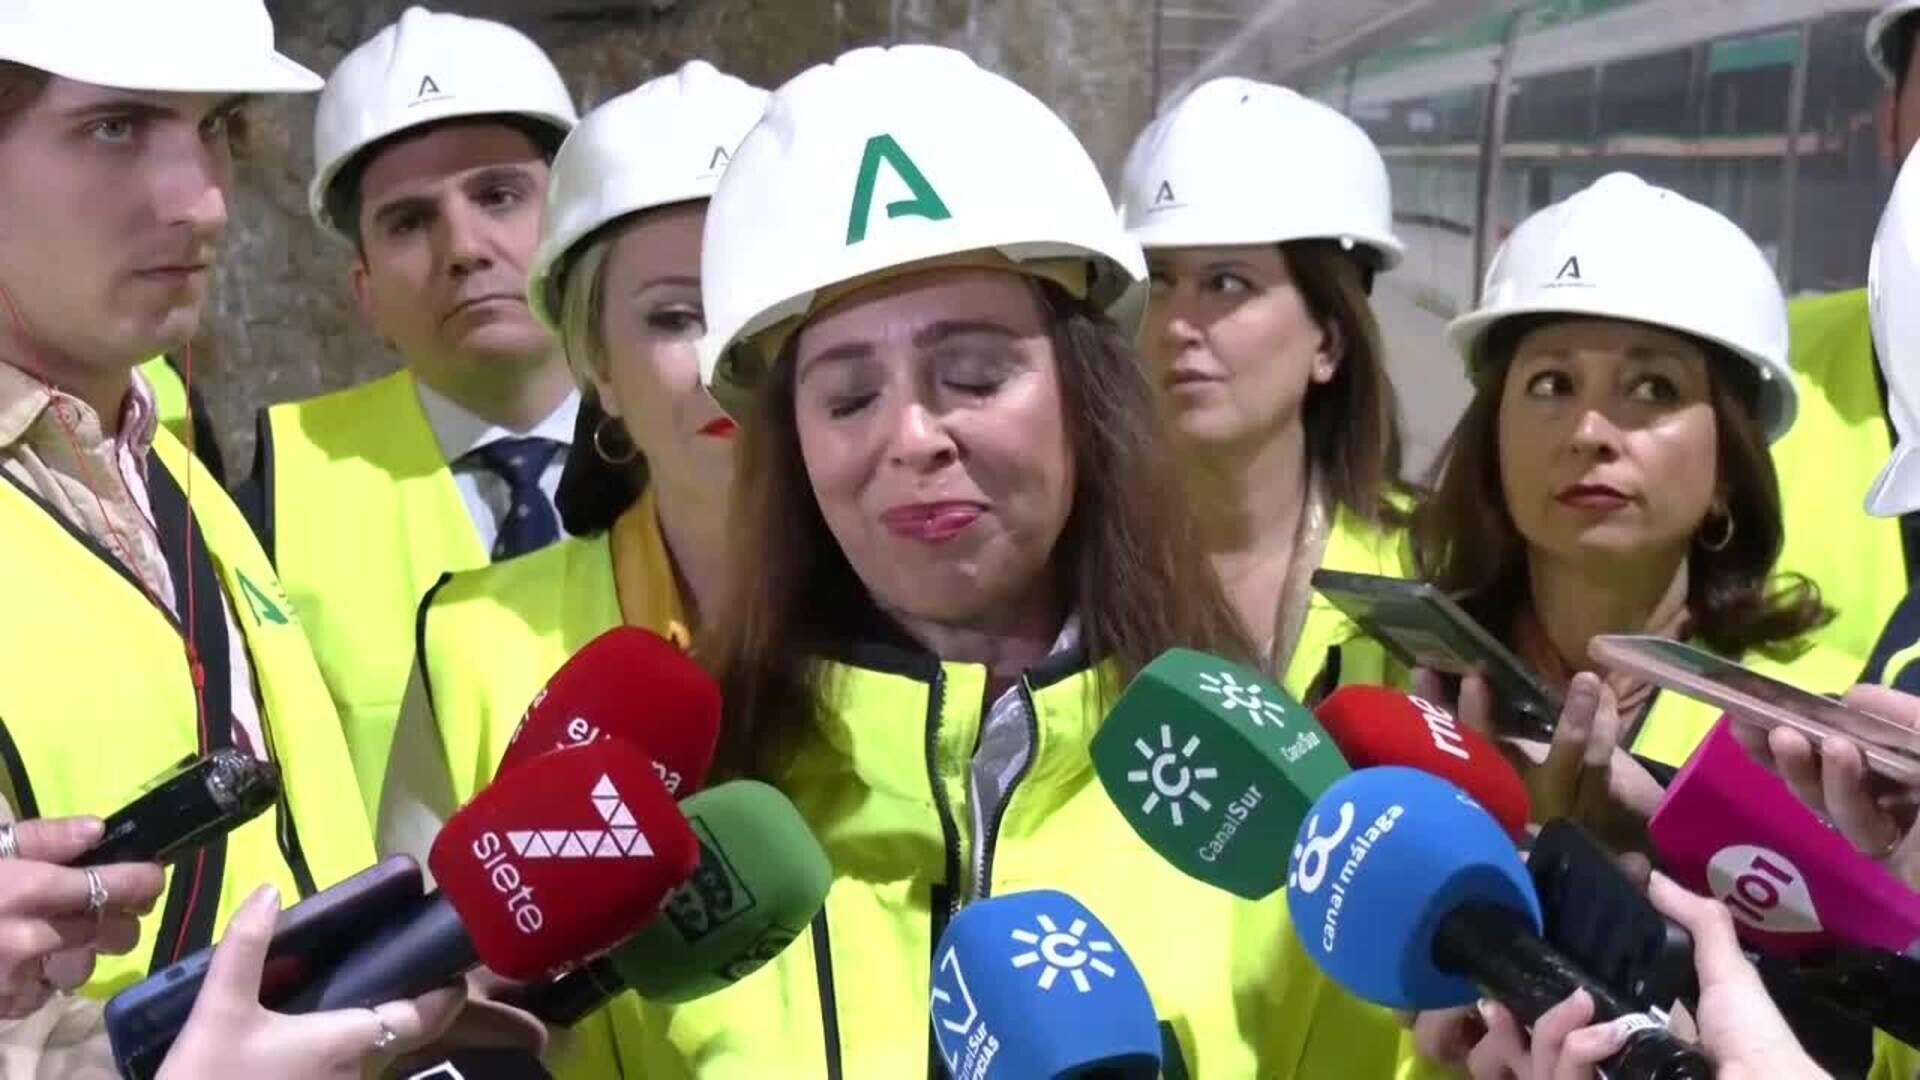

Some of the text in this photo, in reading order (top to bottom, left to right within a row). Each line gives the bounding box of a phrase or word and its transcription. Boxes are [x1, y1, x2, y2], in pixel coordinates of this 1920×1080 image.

[846, 133, 952, 246] A
[1406, 695, 1470, 760] rne
[473, 831, 543, 933] siete
[1725, 854, 1794, 922] 101
